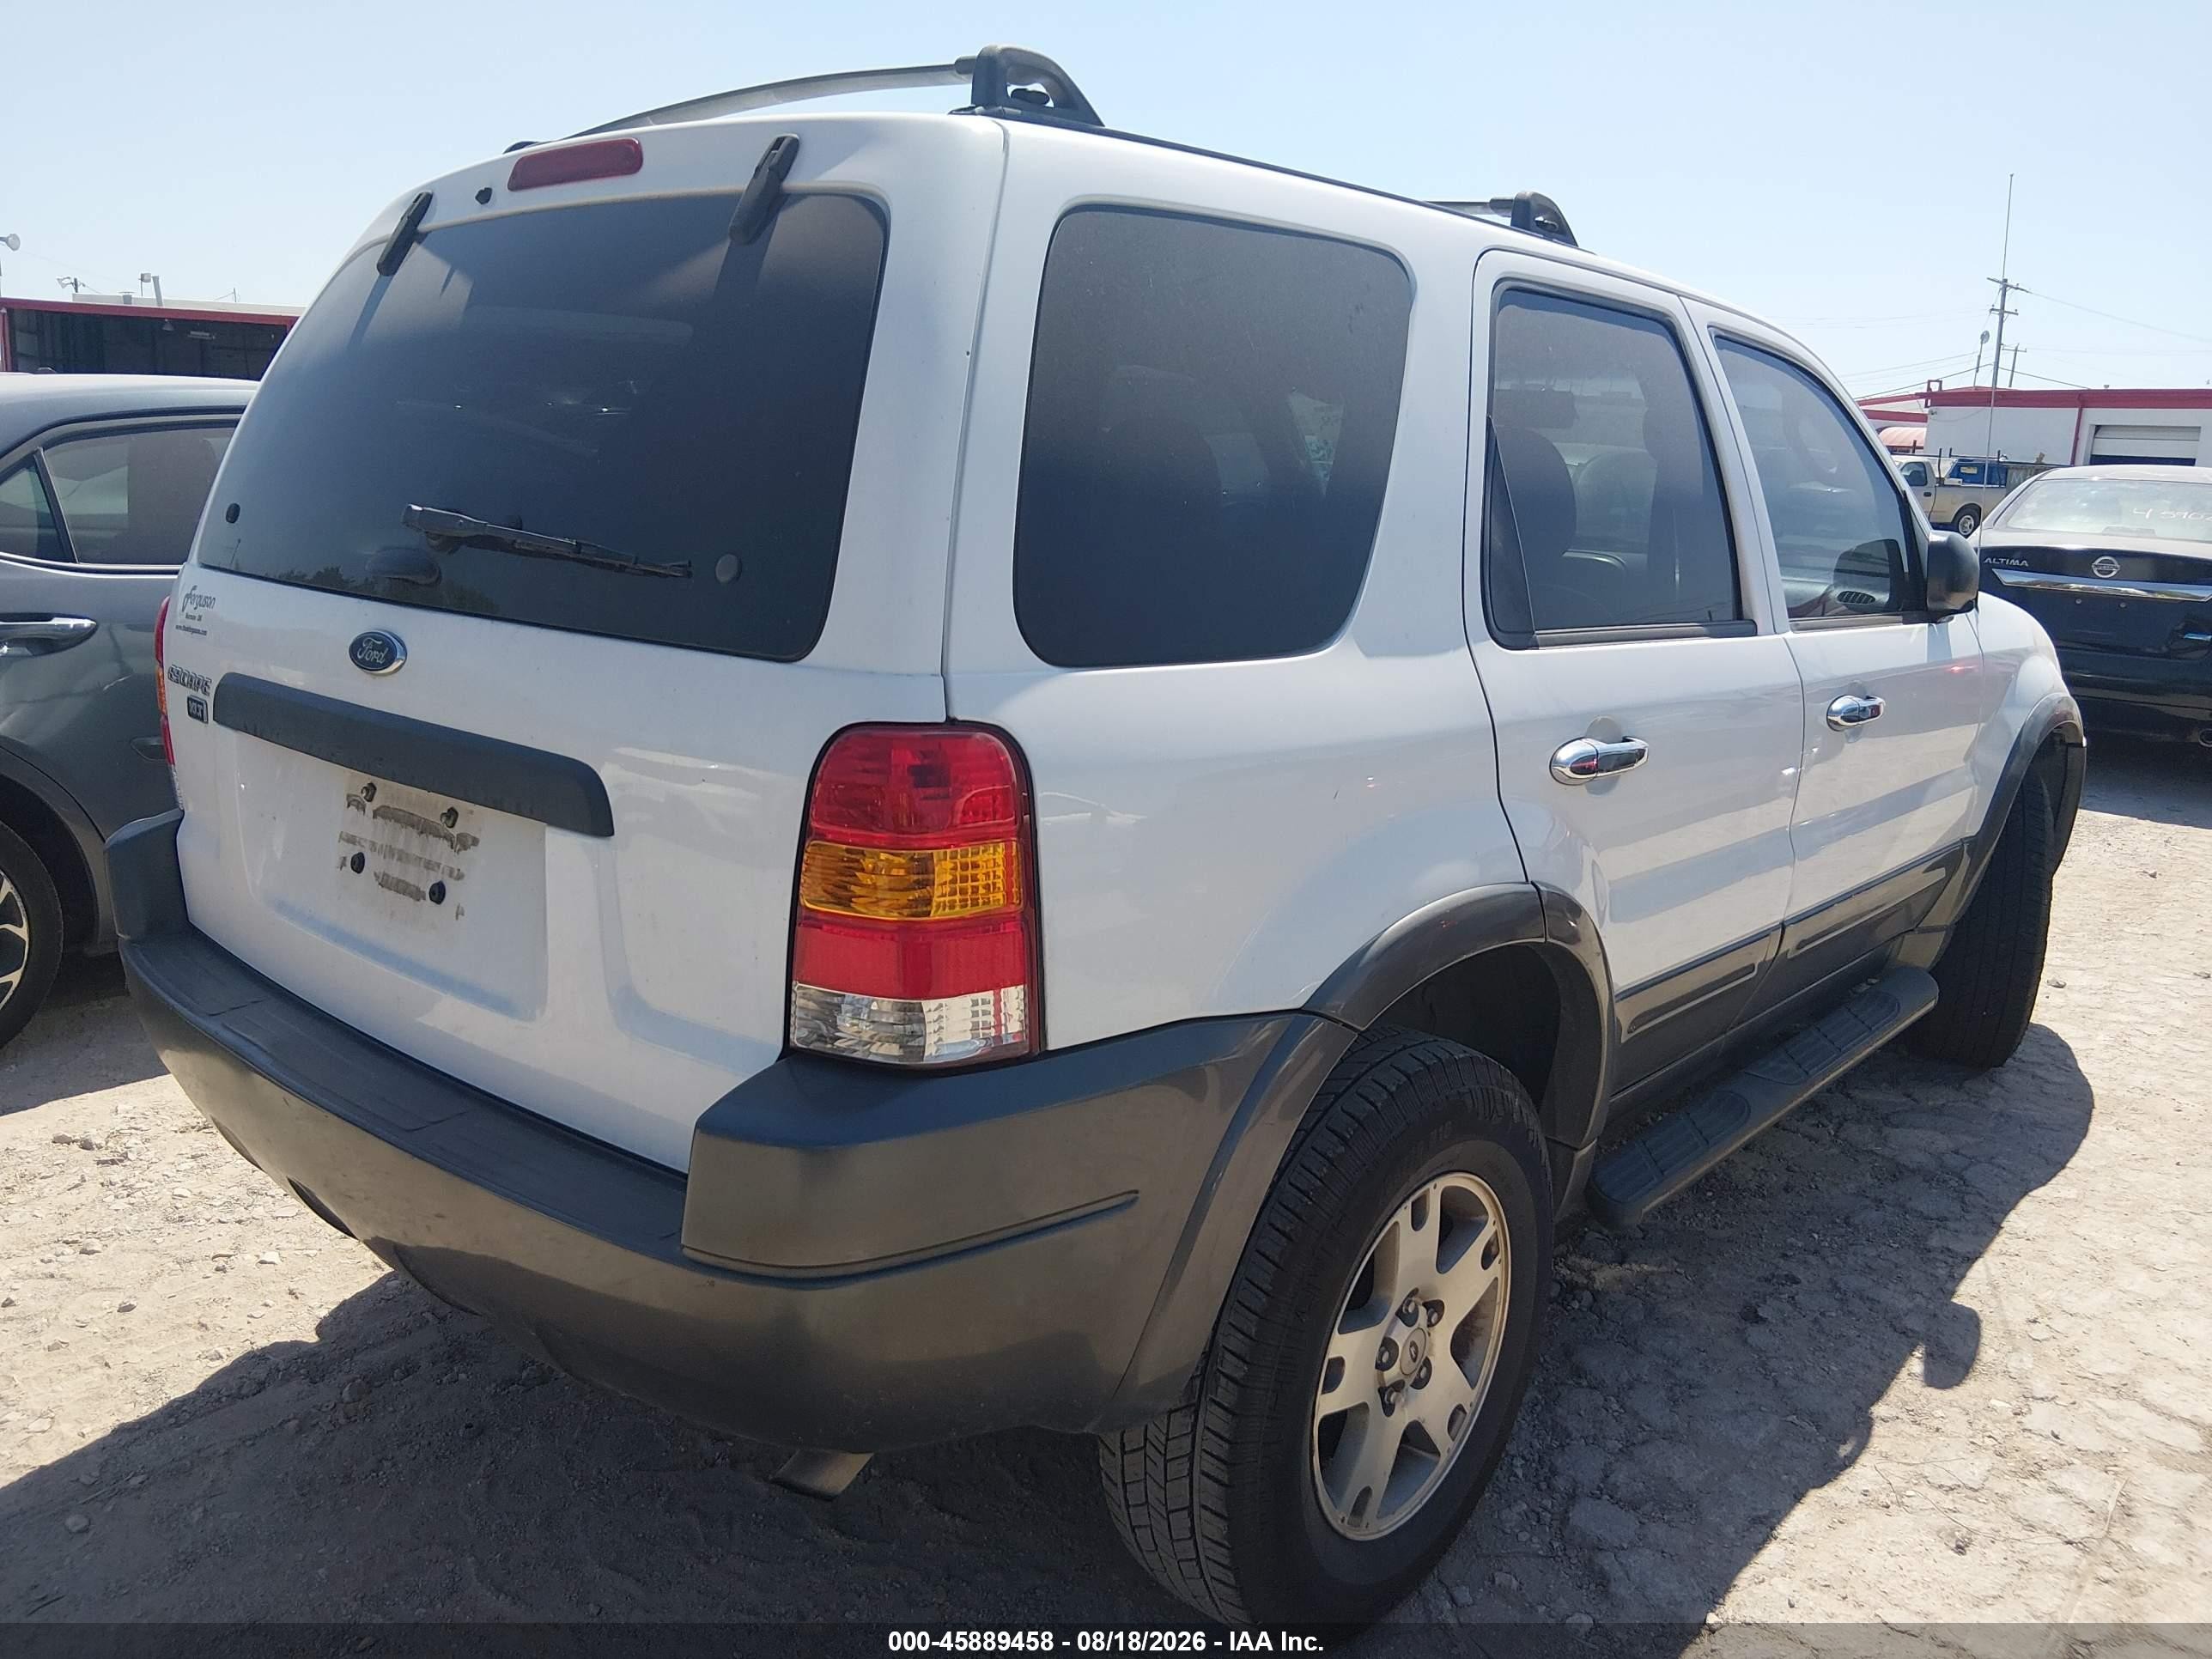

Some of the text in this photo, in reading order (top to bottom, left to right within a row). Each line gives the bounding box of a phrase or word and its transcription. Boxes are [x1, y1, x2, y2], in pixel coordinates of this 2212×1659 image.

[1984, 557, 2029, 568] ALTIMA
[181, 584, 216, 612] Ferguson
[356, 637, 389, 665] Ford
[167, 663, 212, 696] ESCAPE
